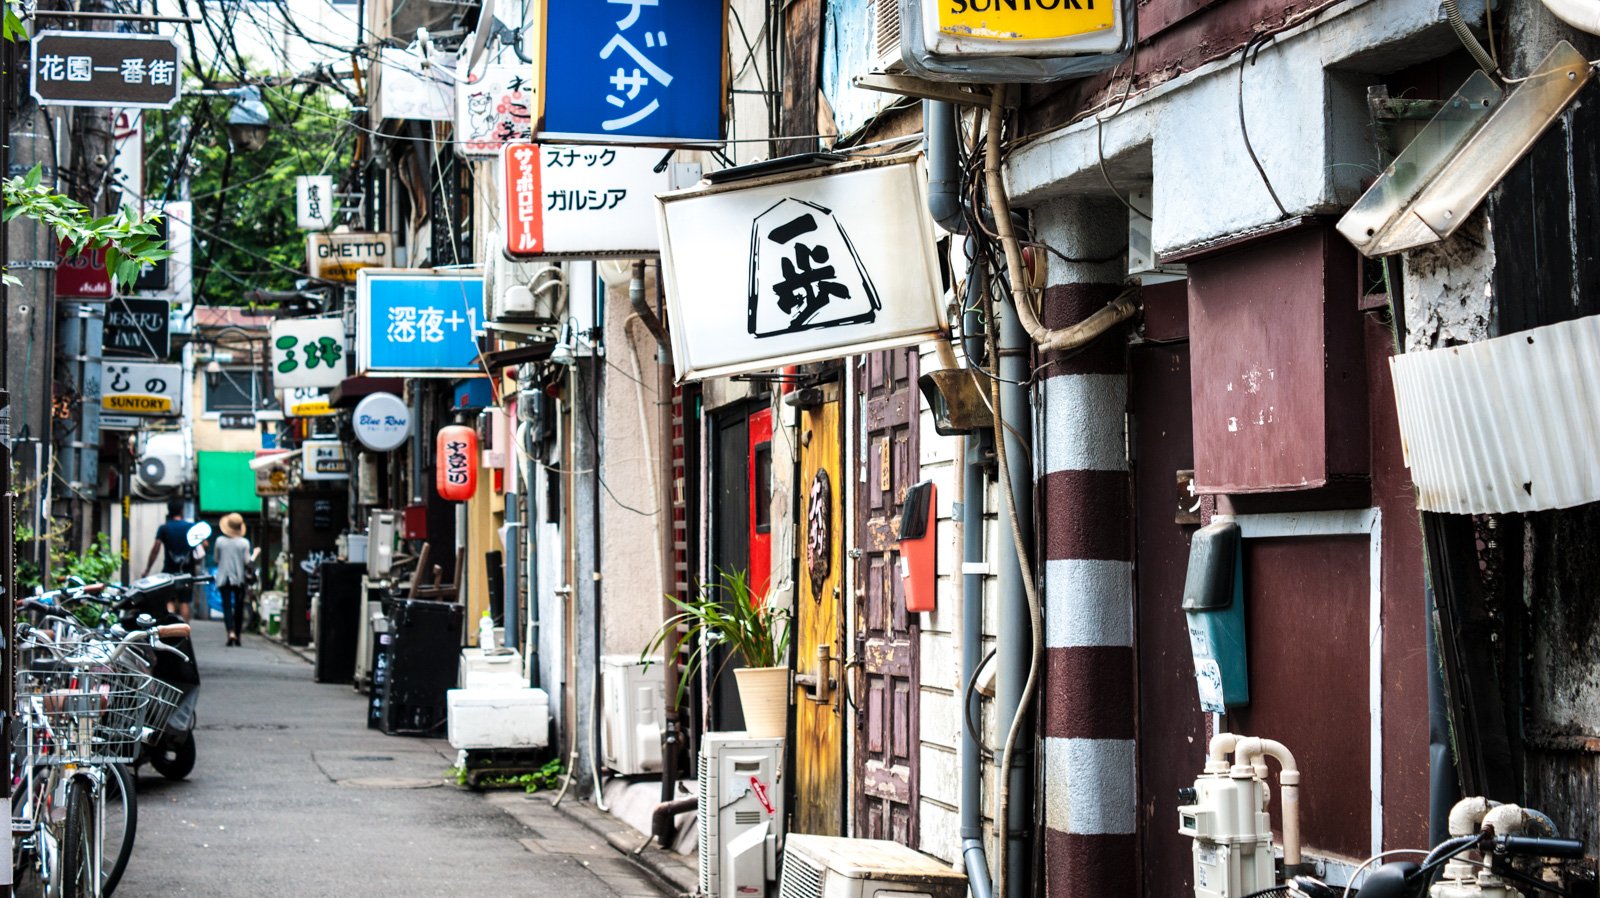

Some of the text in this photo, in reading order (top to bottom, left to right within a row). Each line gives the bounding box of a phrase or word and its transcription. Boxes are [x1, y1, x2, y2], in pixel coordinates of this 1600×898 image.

[39, 55, 175, 86] 花園一番街
[547, 149, 616, 168] スナック
[514, 148, 537, 250] サッポロビール
[547, 189, 627, 211] ガルシア
[318, 242, 386, 258] GHETTO
[768, 213, 851, 327] 一歩
[387, 306, 477, 343] 深夜+1
[115, 330, 143, 347] INN
[276, 336, 342, 373] 三坪
[110, 396, 164, 409] SUNTORY
[360, 415, 406, 426] Blue Rose
